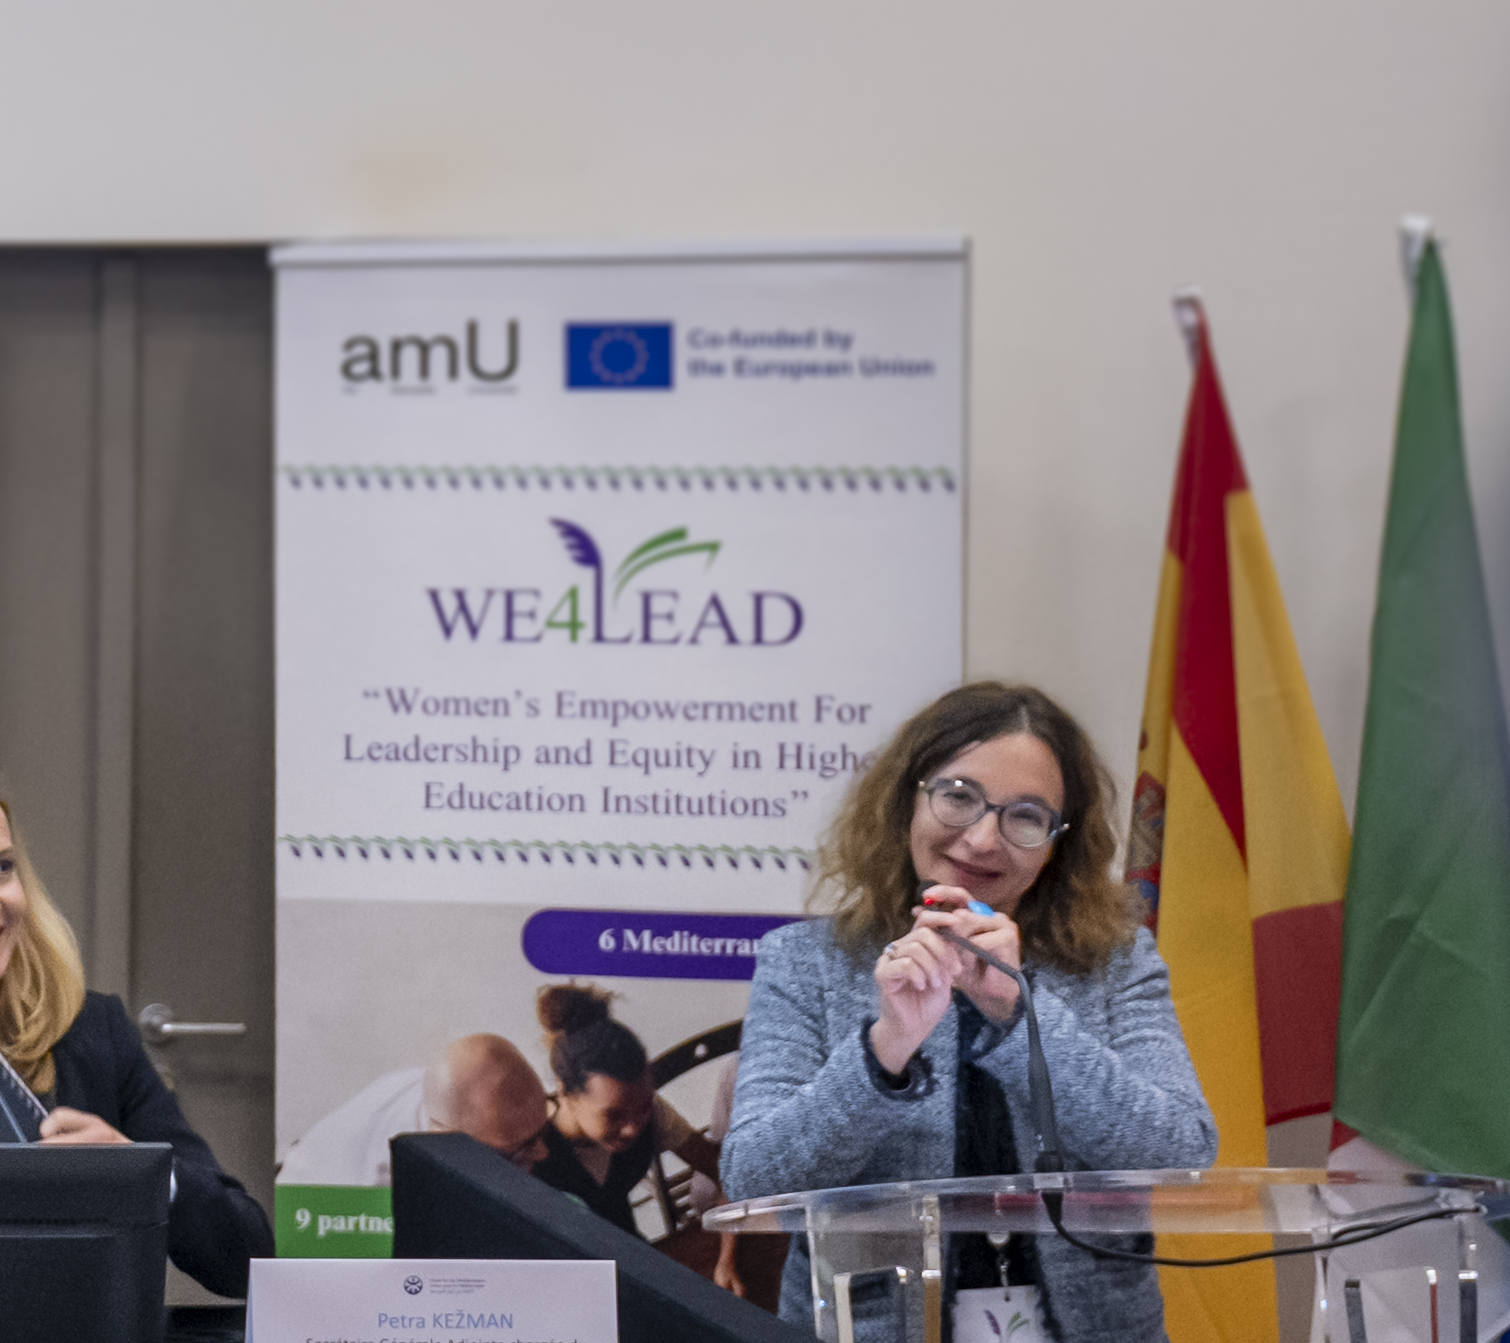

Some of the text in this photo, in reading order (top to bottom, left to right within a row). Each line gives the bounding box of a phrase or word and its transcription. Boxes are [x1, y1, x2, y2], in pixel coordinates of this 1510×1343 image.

[340, 318, 519, 383] amU
[822, 328, 853, 352] by
[686, 355, 936, 381] the European Union
[425, 563, 805, 646] WE4LEAD
[555, 690, 797, 728] Empowerment
[814, 693, 871, 724] For
[342, 733, 762, 776] Leadership and Equity in
[423, 781, 586, 813] Education
[378, 1310, 513, 1329] Petra KEŽMAN
